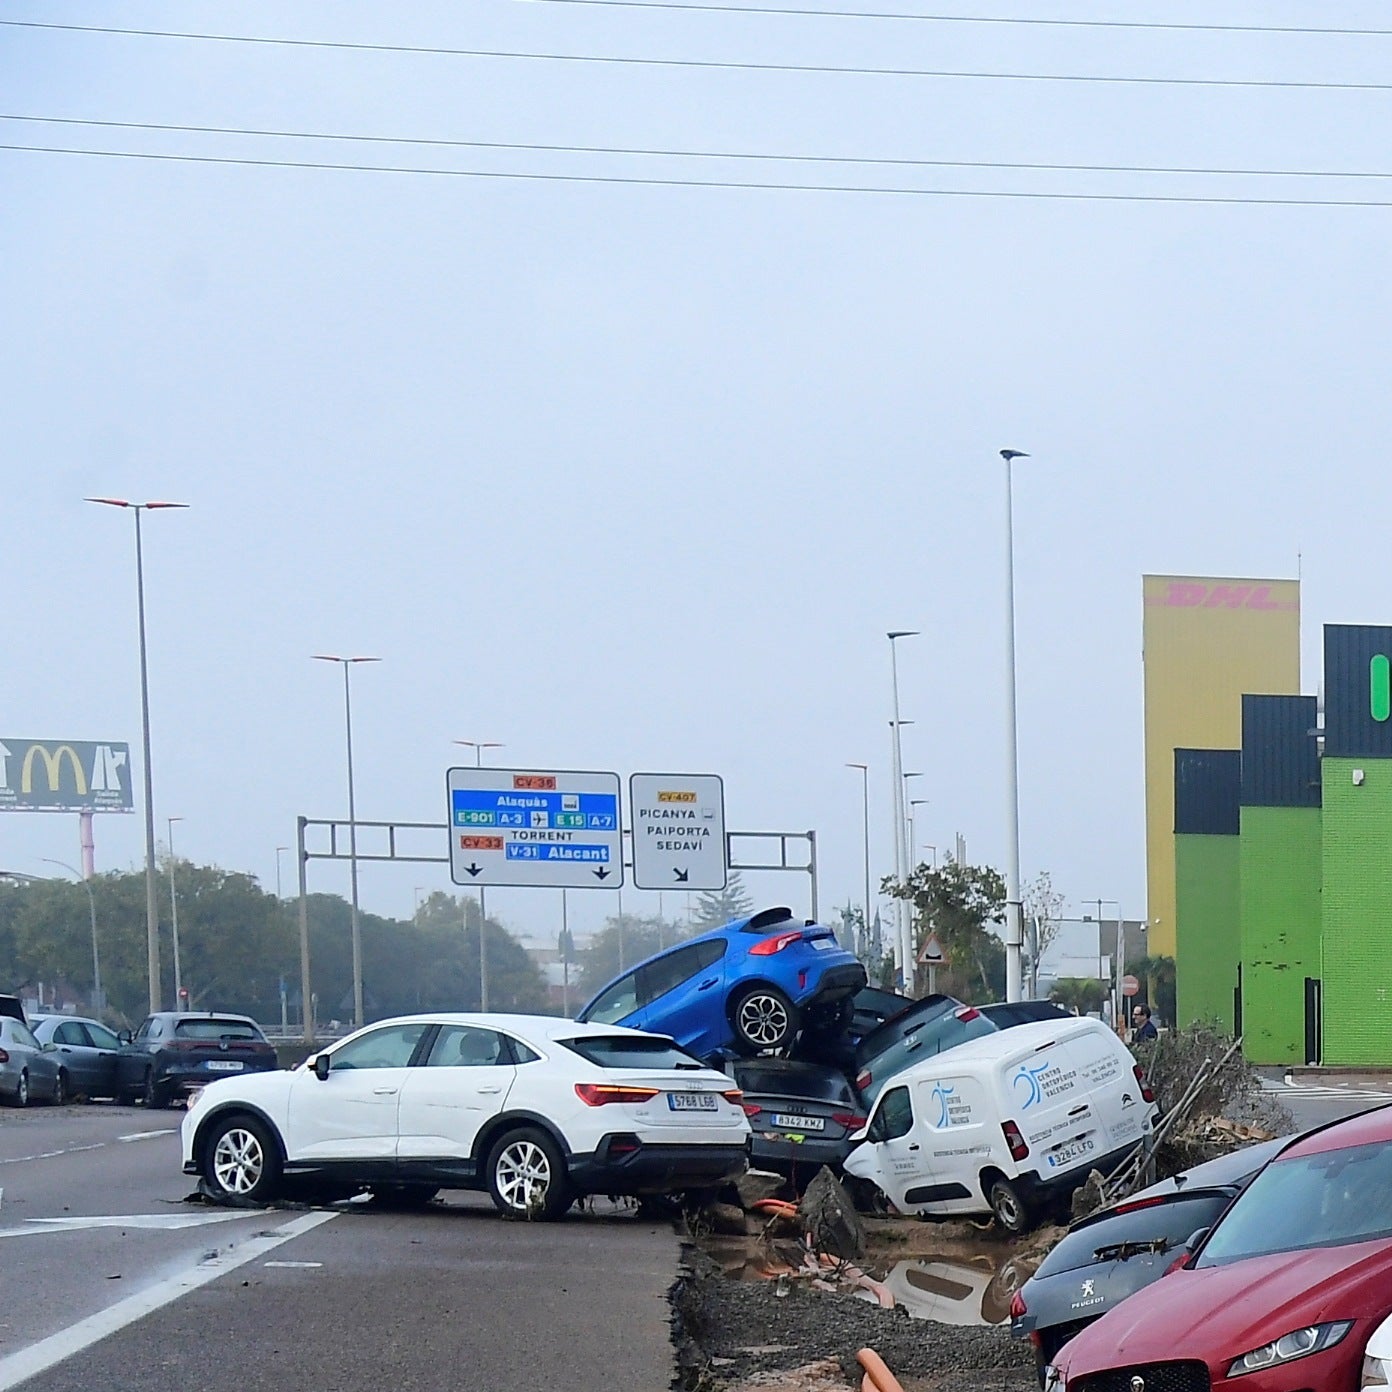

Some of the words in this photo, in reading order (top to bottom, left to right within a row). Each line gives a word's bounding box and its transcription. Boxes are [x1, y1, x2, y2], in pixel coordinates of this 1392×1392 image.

[1166, 583, 1278, 610] DHL
[457, 812, 493, 823] E-901
[501, 813, 523, 824] A-3
[591, 815, 612, 826] A-7
[640, 809, 696, 819] PICANYA
[511, 831, 574, 842] TORRENT
[647, 826, 710, 836] PAIPORTA
[511, 846, 537, 857] V-31
[548, 847, 608, 860] Alacant
[1037, 1067, 1061, 1081] CENTRO
[1046, 1081, 1075, 1098] VALENCIA
